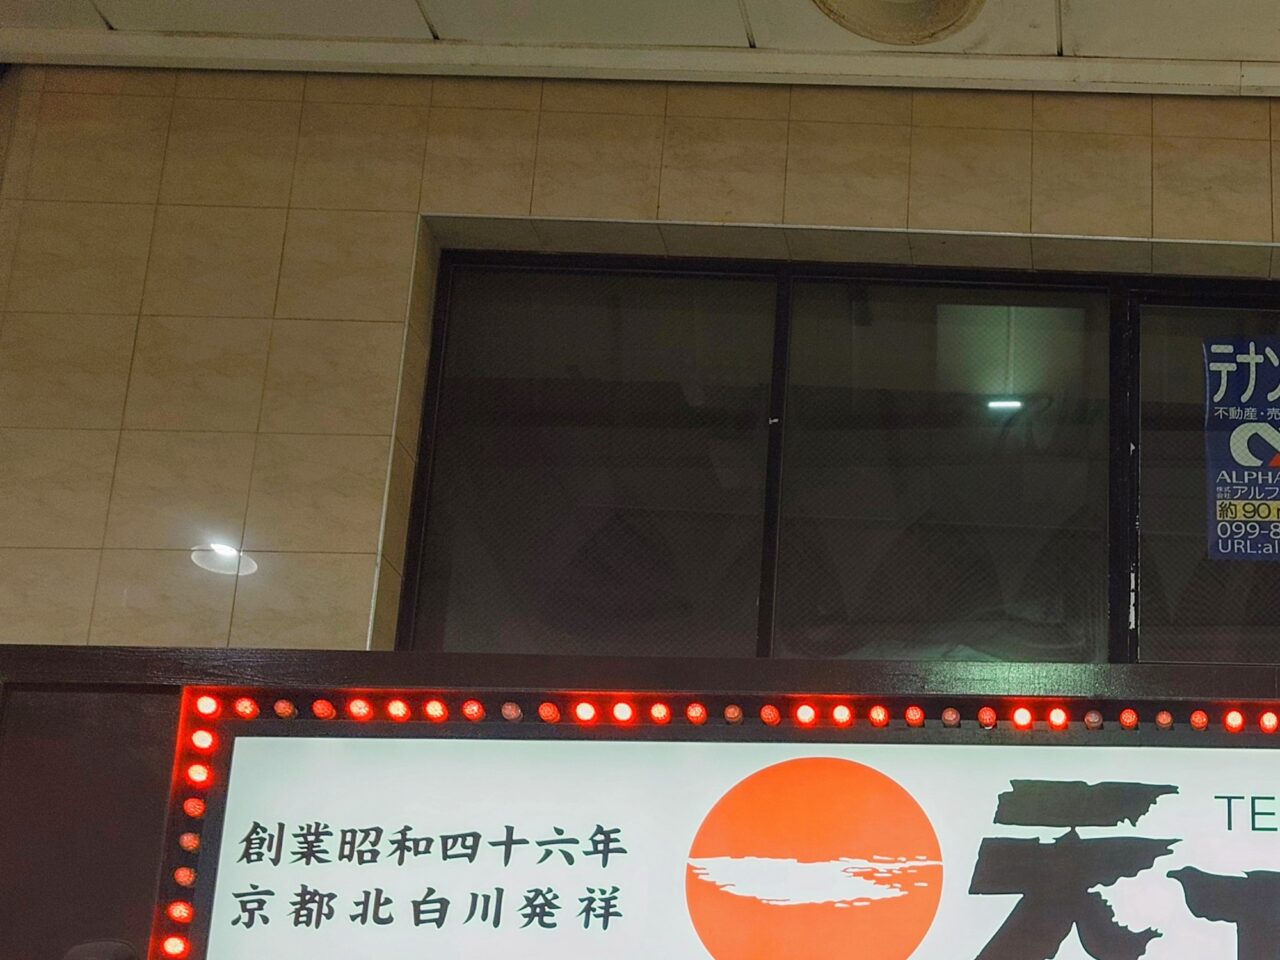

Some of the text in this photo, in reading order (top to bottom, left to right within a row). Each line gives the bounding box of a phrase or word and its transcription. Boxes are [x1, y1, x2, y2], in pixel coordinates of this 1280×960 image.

[237, 821, 628, 868] 創業昭和四十六年
[230, 884, 624, 930] 京都北白川発祥
